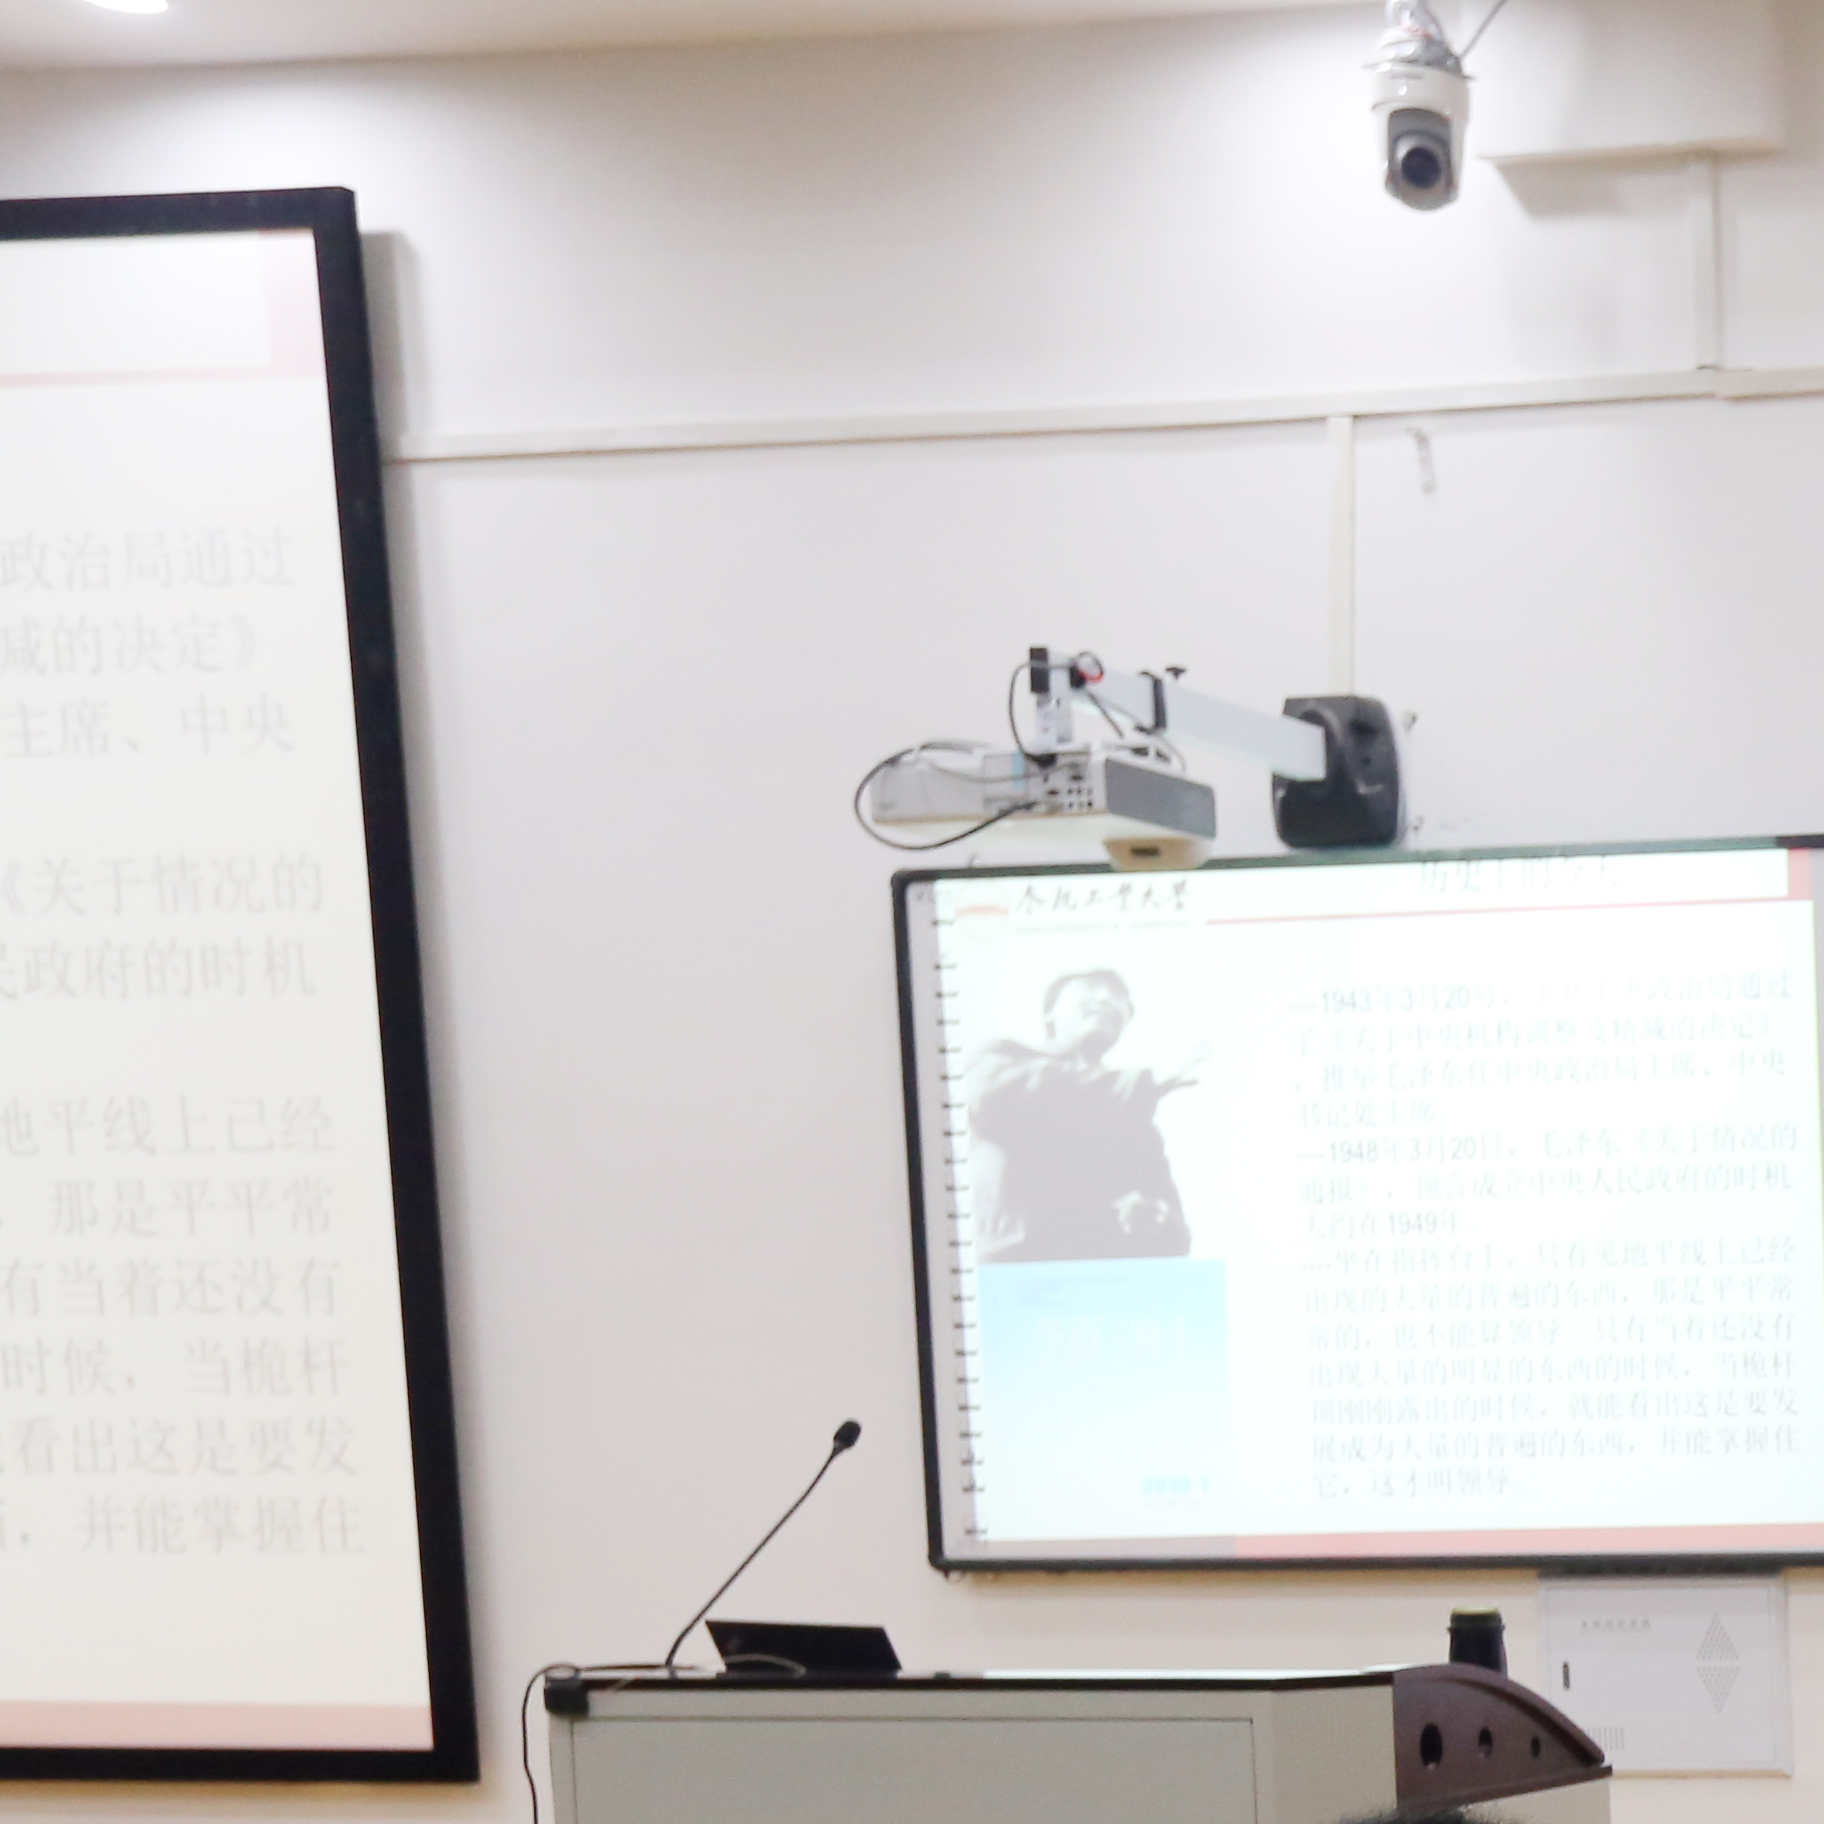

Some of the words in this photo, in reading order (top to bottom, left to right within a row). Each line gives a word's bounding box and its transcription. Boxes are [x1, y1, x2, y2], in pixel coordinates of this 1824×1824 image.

[0, 1414, 360, 1479] 看出这是要发
[0, 1492, 364, 1557] ，并能掌握住
